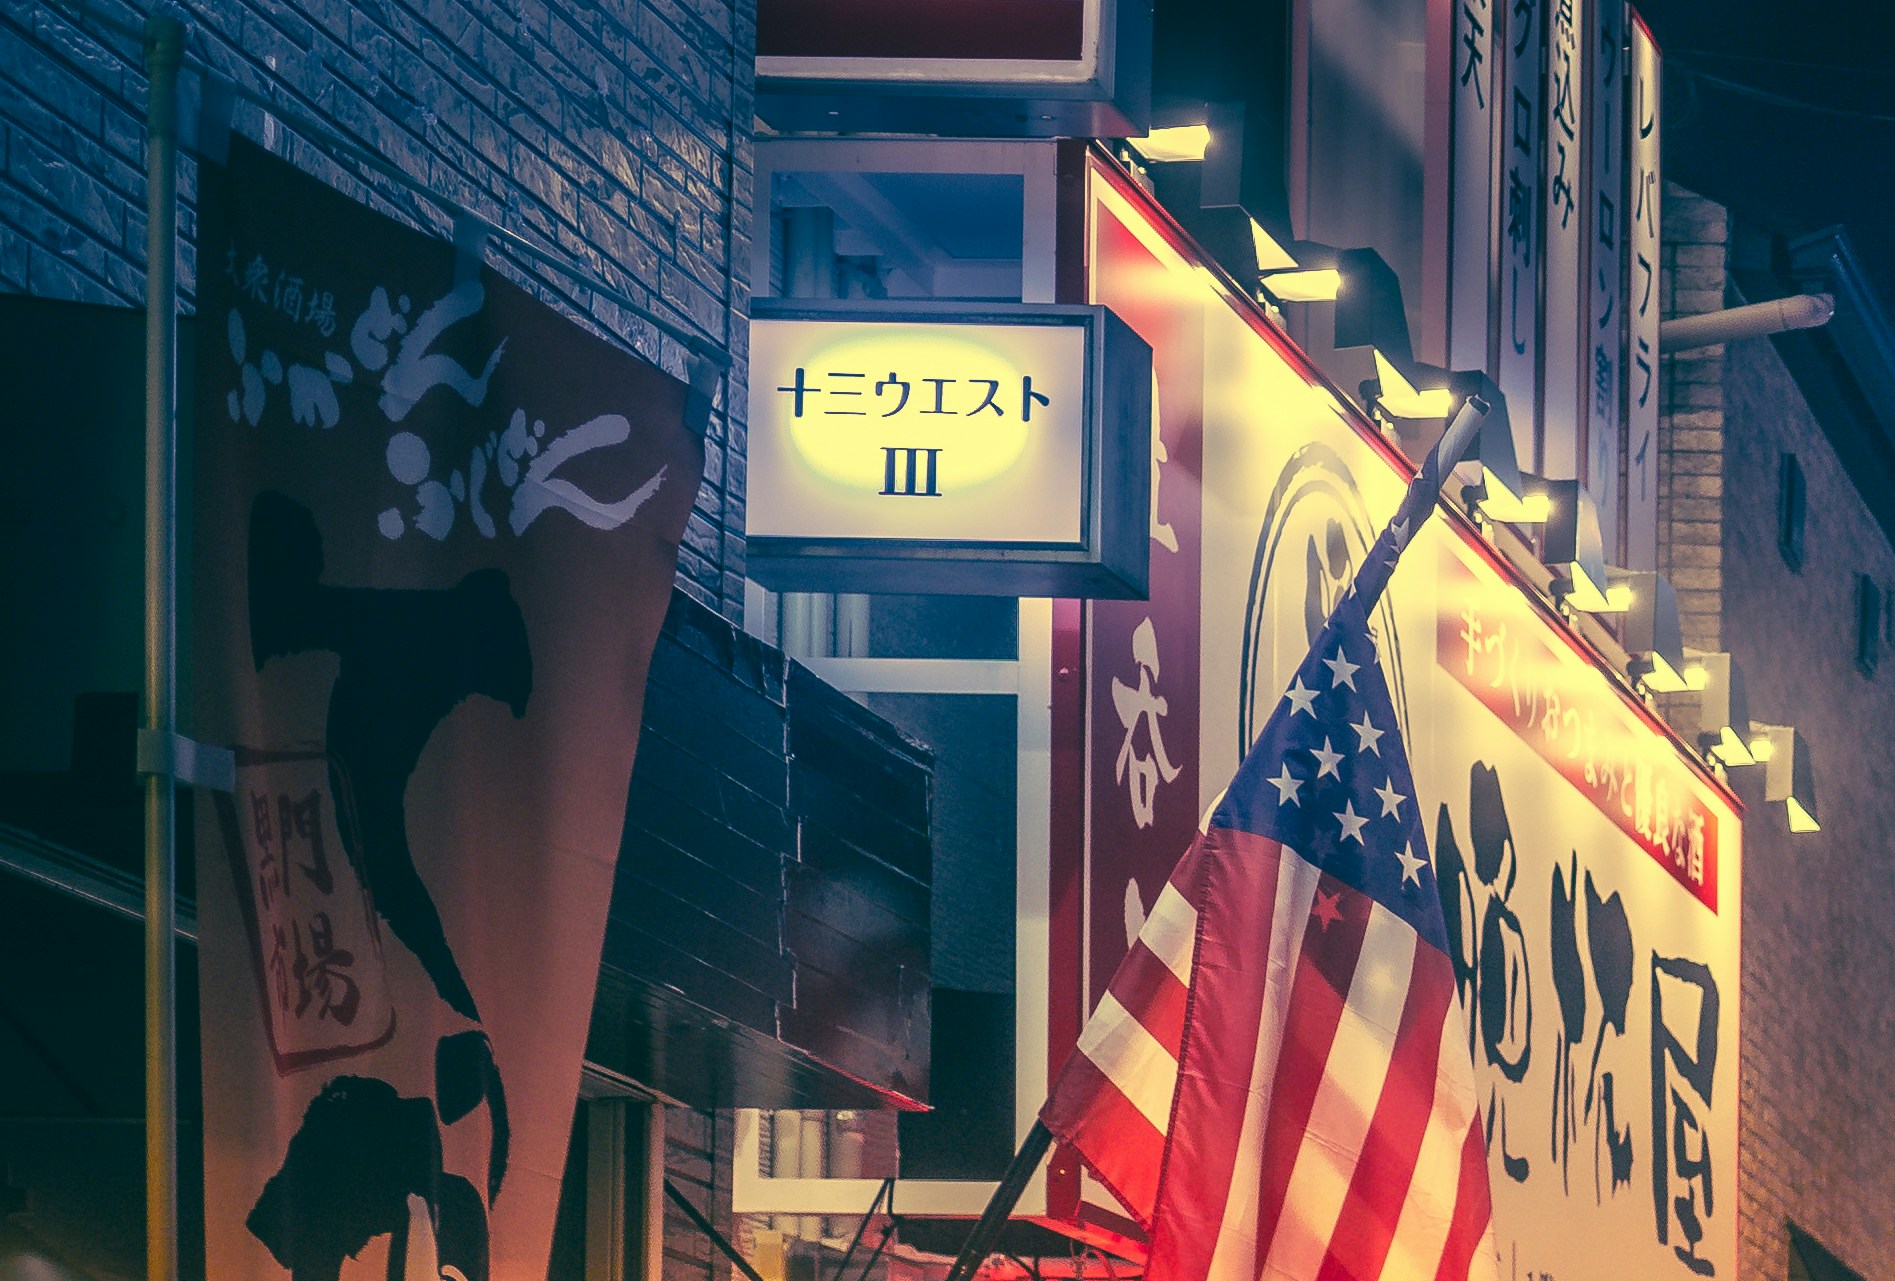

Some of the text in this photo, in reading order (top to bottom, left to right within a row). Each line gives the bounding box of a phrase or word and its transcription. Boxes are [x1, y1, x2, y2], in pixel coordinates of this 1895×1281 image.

[777, 367, 1050, 422] 十三ウエスト
